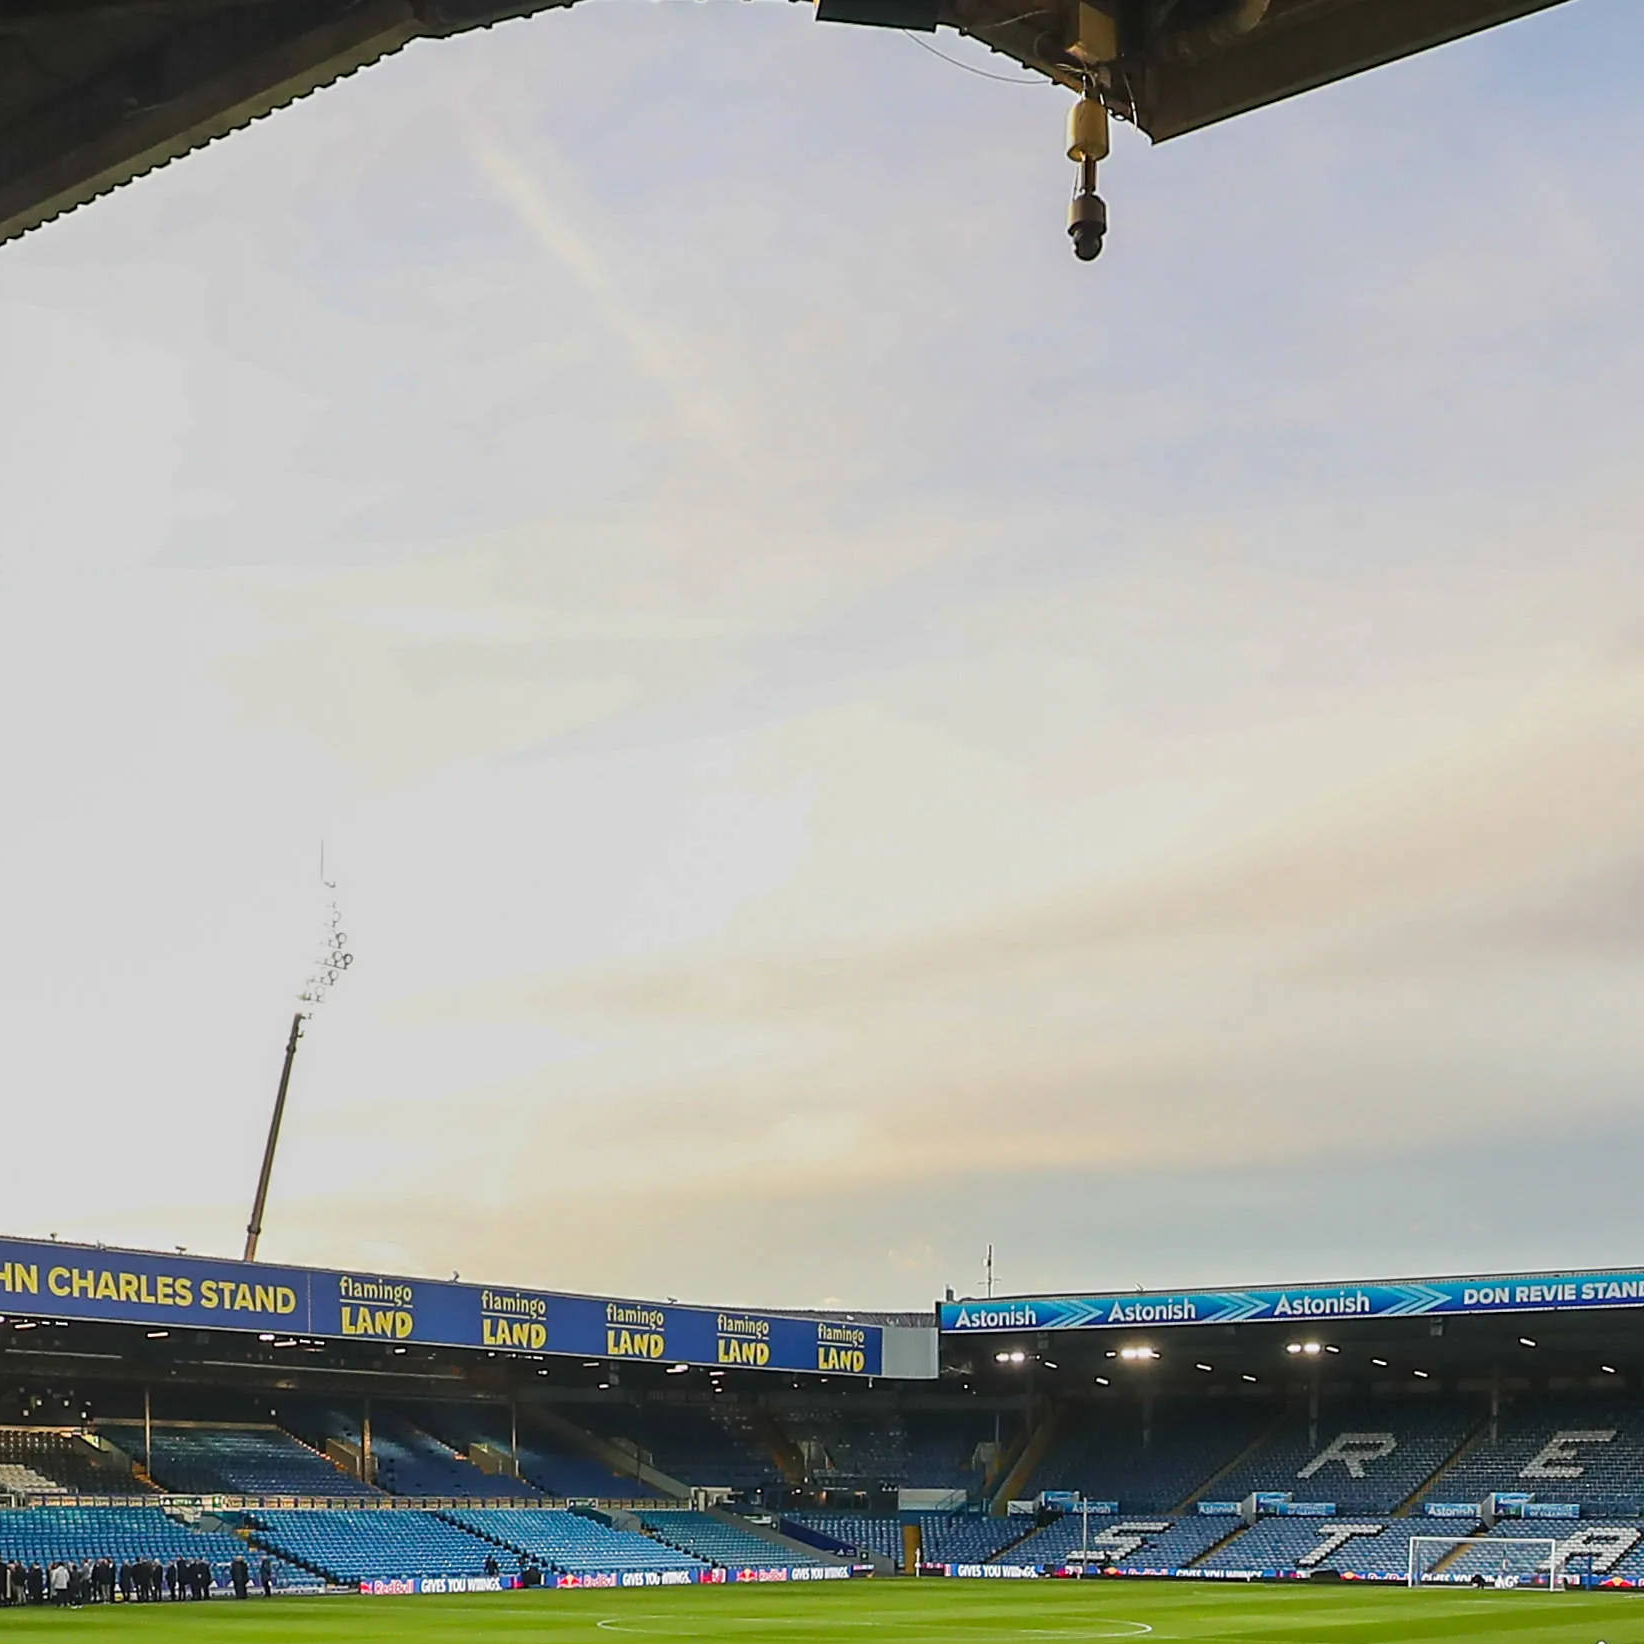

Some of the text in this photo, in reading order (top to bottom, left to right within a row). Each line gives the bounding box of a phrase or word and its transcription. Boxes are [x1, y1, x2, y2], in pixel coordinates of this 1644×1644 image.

[48, 1266, 193, 1307] CHARLES
[200, 1280, 296, 1314] STAND
[339, 1275, 412, 1307] flamingo
[1273, 1288, 1371, 1317] Astonish
[1463, 1285, 1511, 1305] DON
[1515, 1283, 1578, 1303] REVIE
[481, 1290, 546, 1319] flamingo
[606, 1302, 664, 1330] flamingo
[955, 1304, 1037, 1329] Astonish
[1107, 1297, 1196, 1323] Astonish
[341, 1306, 414, 1339] LAND
[483, 1318, 547, 1349] LAND
[716, 1313, 769, 1339] flamingo
[817, 1323, 865, 1348] flamingo
[607, 1329, 665, 1358] LAND
[718, 1339, 770, 1366] LAND
[818, 1346, 865, 1372] LAND
[622, 1572, 644, 1586] GIVES
[811, 1566, 824, 1580] YOU
[958, 1564, 982, 1578] GIVES
[983, 1564, 1001, 1578] YOU
[421, 1578, 445, 1593] GIVES
[447, 1577, 466, 1592] YOU
